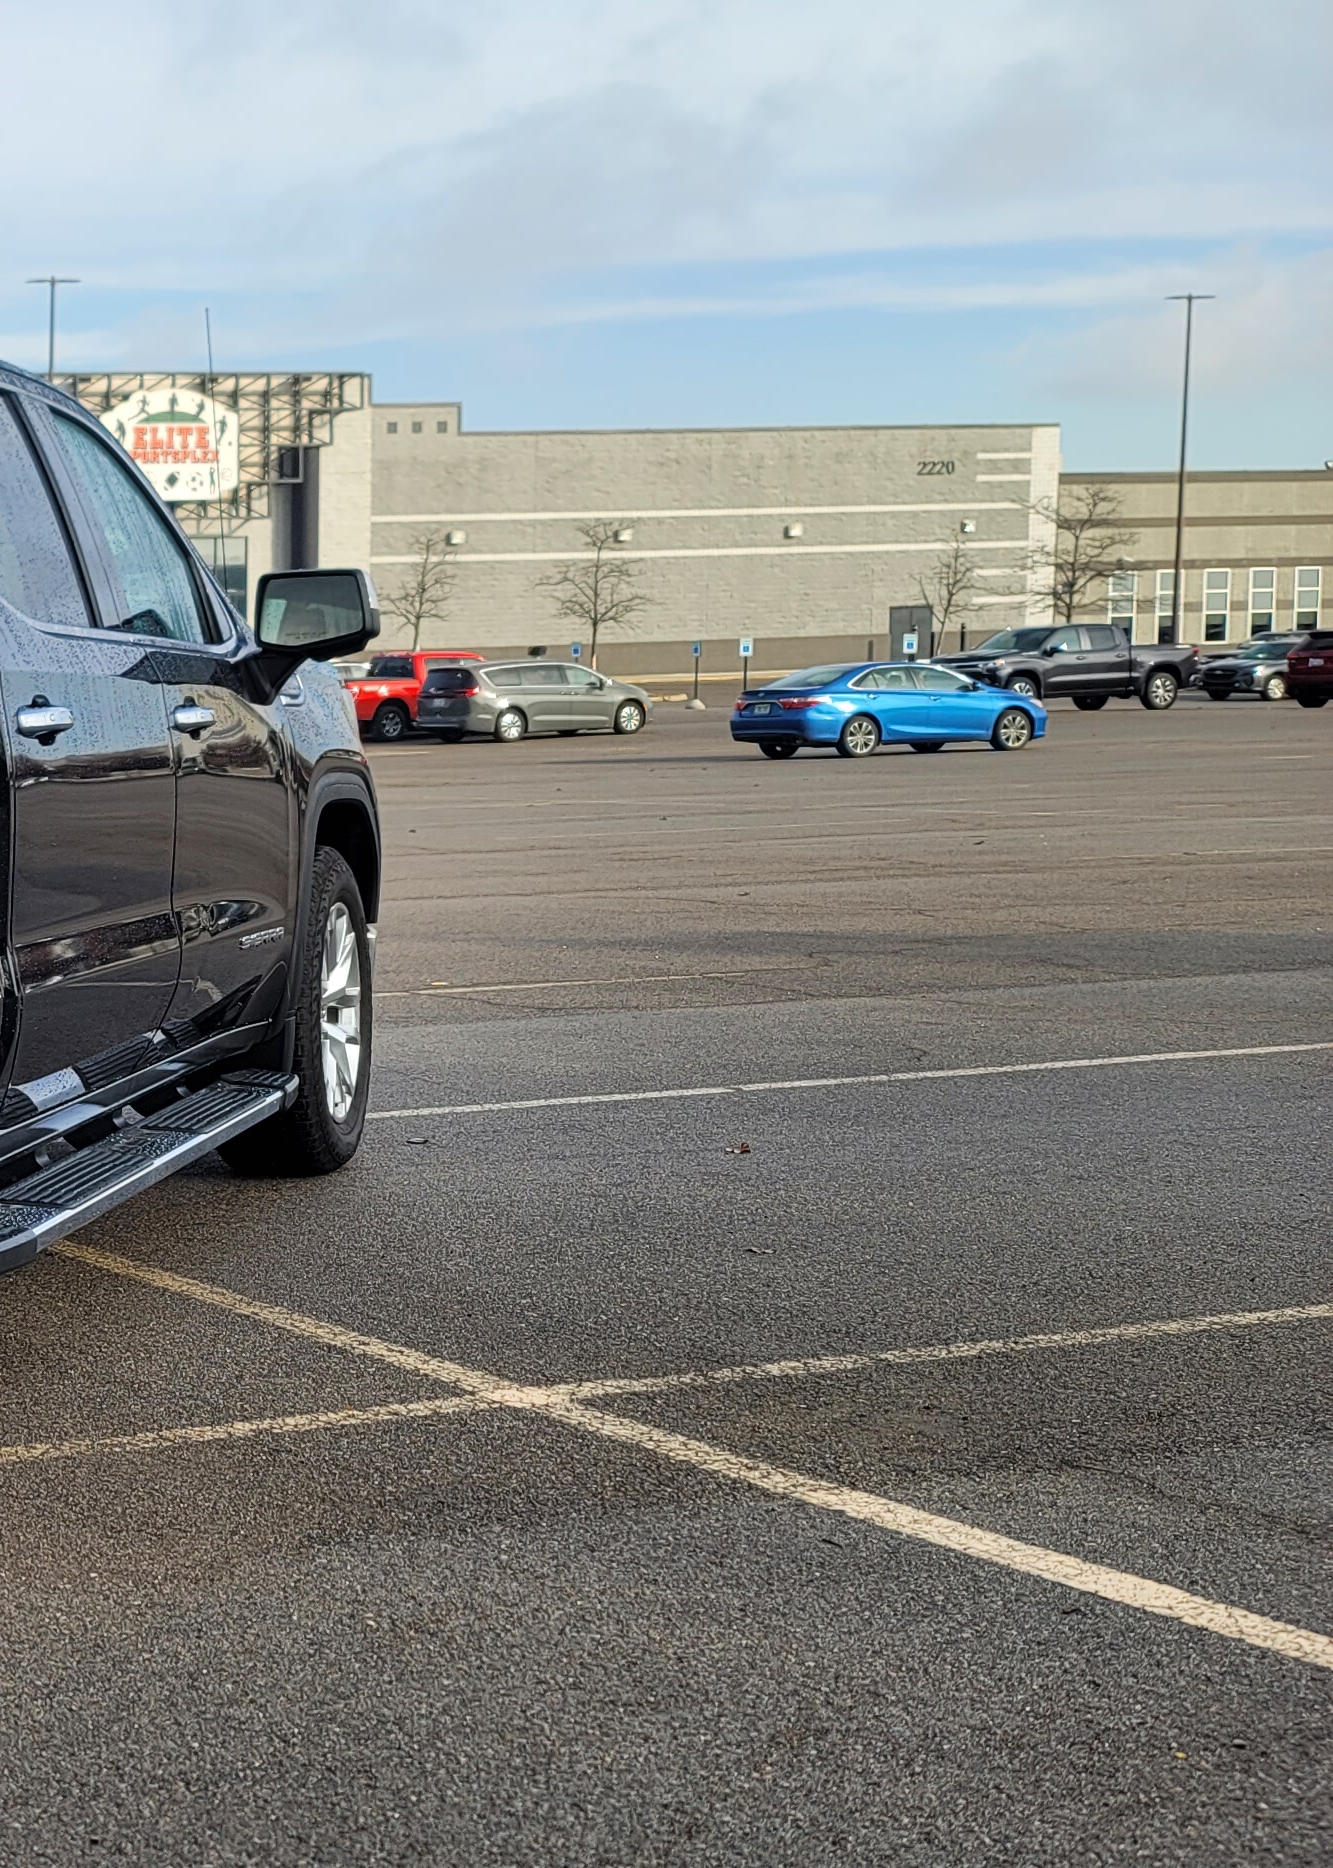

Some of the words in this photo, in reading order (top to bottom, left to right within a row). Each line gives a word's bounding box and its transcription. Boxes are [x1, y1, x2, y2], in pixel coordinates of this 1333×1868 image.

[132, 426, 210, 449] ELITE
[130, 449, 220, 464] PORTSPLEX
[917, 461, 955, 476] 2220
